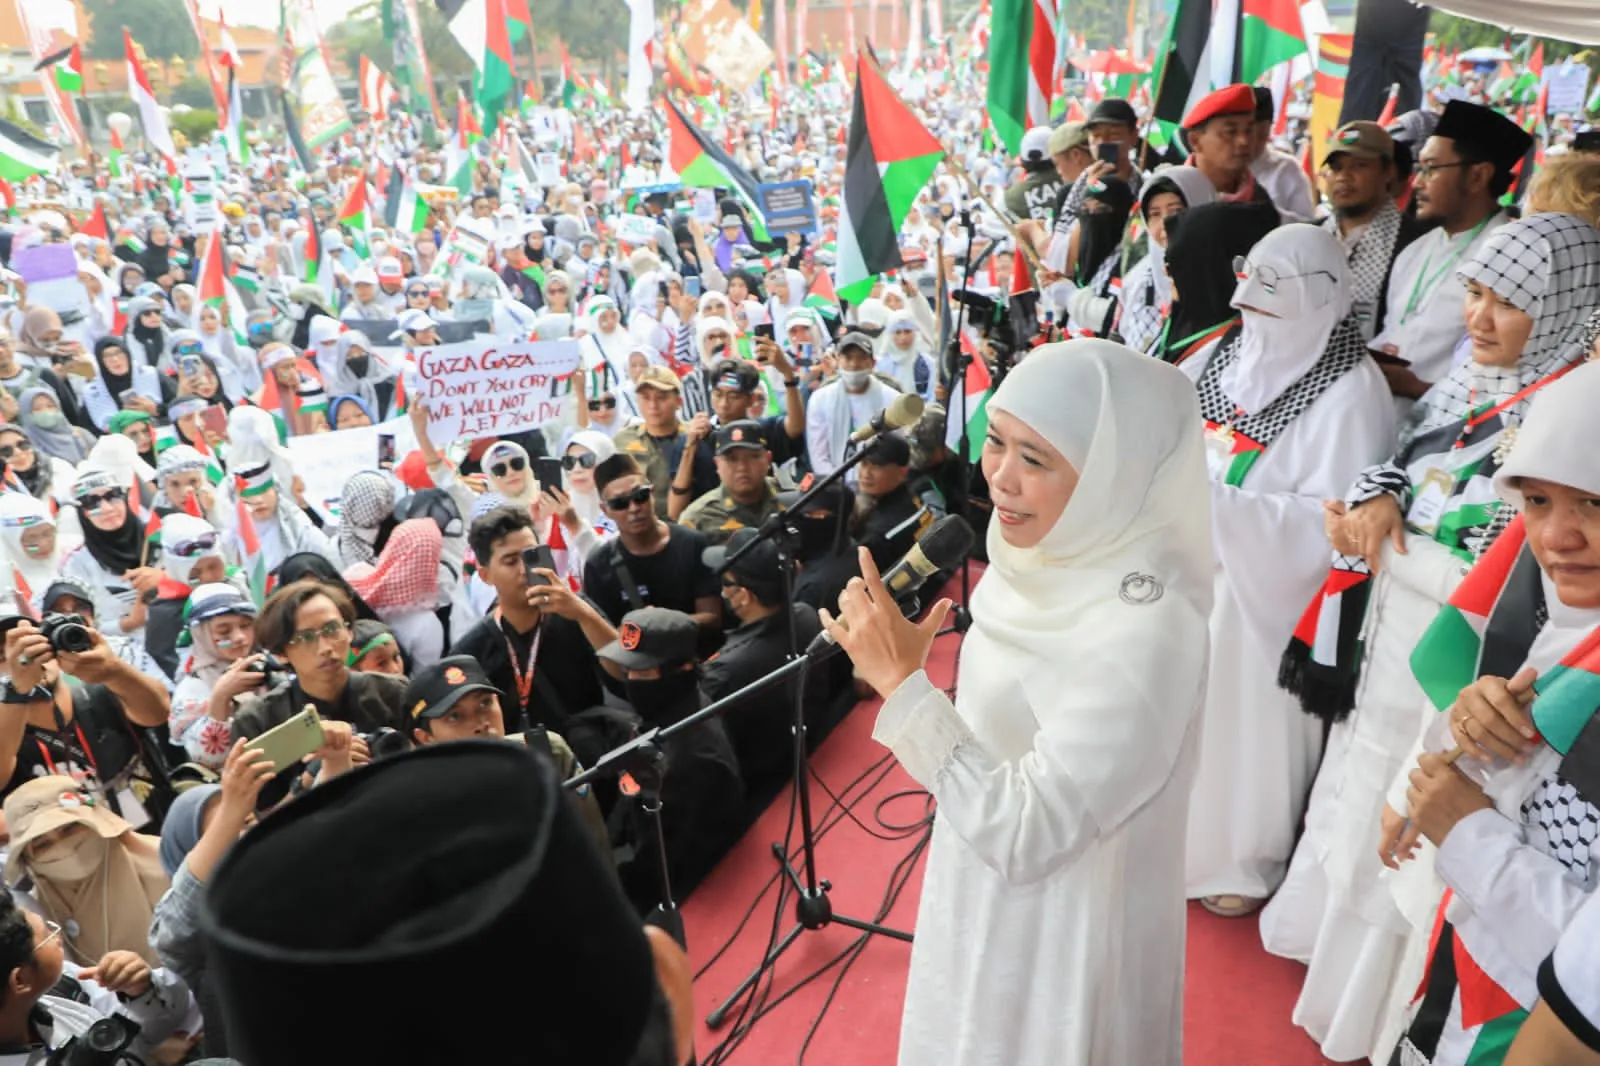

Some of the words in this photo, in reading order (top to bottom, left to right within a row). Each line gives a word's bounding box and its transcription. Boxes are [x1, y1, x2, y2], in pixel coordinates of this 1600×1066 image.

[419, 351, 479, 379] GAZA
[430, 379, 480, 398] DONT
[486, 377, 515, 393] YOU
[519, 374, 550, 388] CRY
[426, 402, 454, 423] WE
[460, 398, 498, 416] WILL
[499, 392, 531, 411] NOT
[458, 414, 500, 435] LET
[507, 410, 535, 427] YOU
